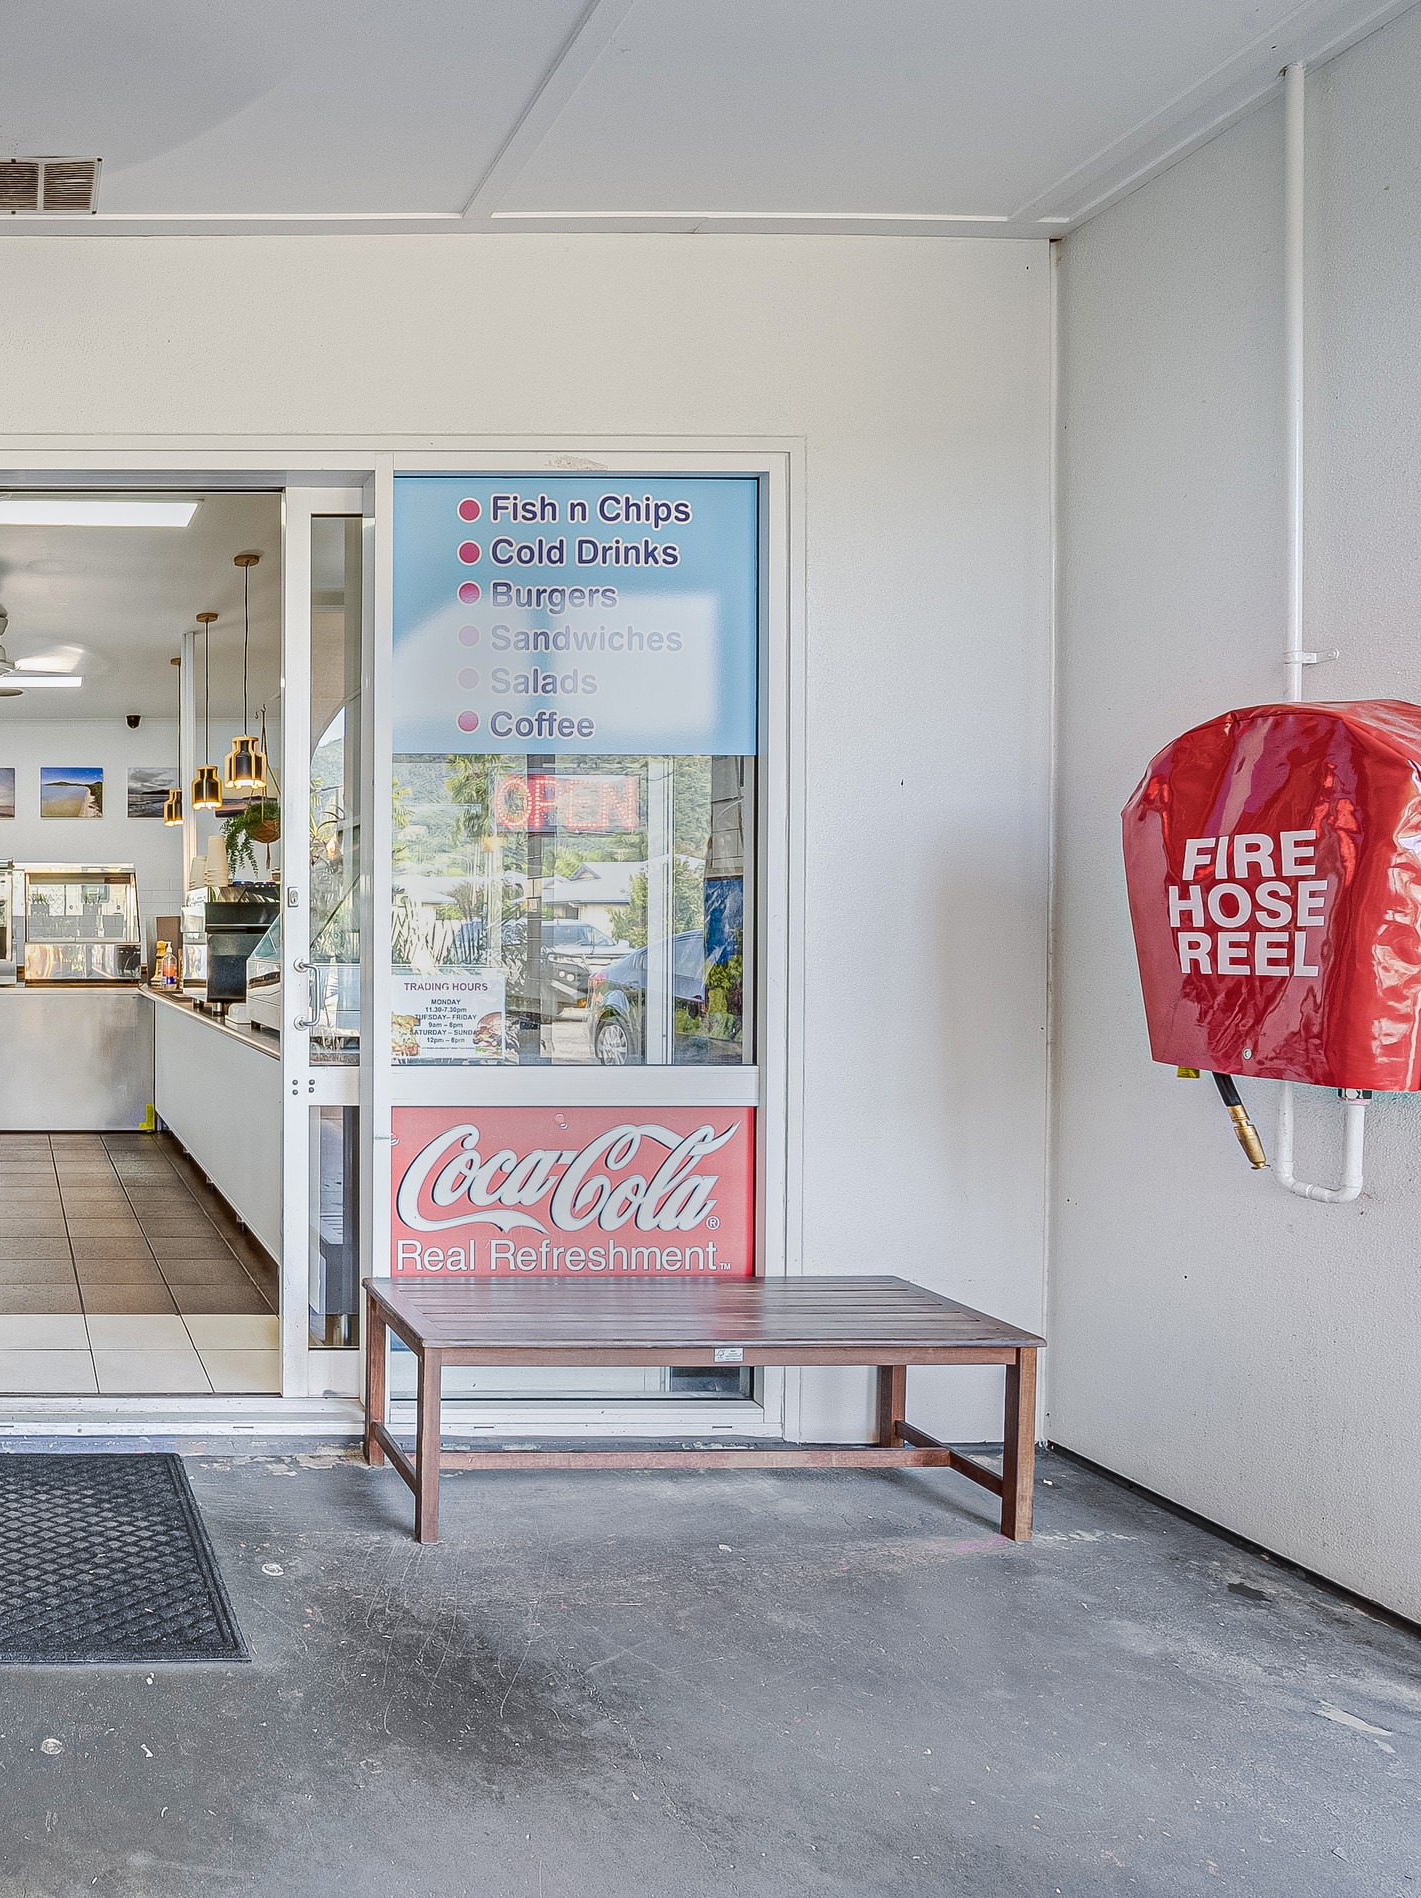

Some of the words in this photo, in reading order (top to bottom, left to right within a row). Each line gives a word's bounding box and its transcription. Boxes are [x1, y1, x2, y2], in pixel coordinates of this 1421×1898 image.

[492, 495, 557, 522] Fish
[570, 502, 587, 522] n
[598, 495, 691, 528] Chips
[491, 539, 565, 565] Cold
[579, 539, 678, 565] Drinks
[492, 582, 617, 614] Burgers
[491, 625, 683, 651] Sandwiches
[492, 668, 598, 694] Salads
[491, 711, 595, 737] Coffee
[496, 776, 640, 829] OPEN
[1182, 829, 1317, 881] FIRE
[1168, 880, 1328, 929] HOSE
[1178, 931, 1319, 977] REEL
[404, 982, 449, 991] TRADING
[452, 982, 488, 991] HOURS
[397, 1119, 742, 1235] Coca-Cola
[397, 1240, 476, 1272] Real
[490, 1239, 718, 1272] Refreshment
